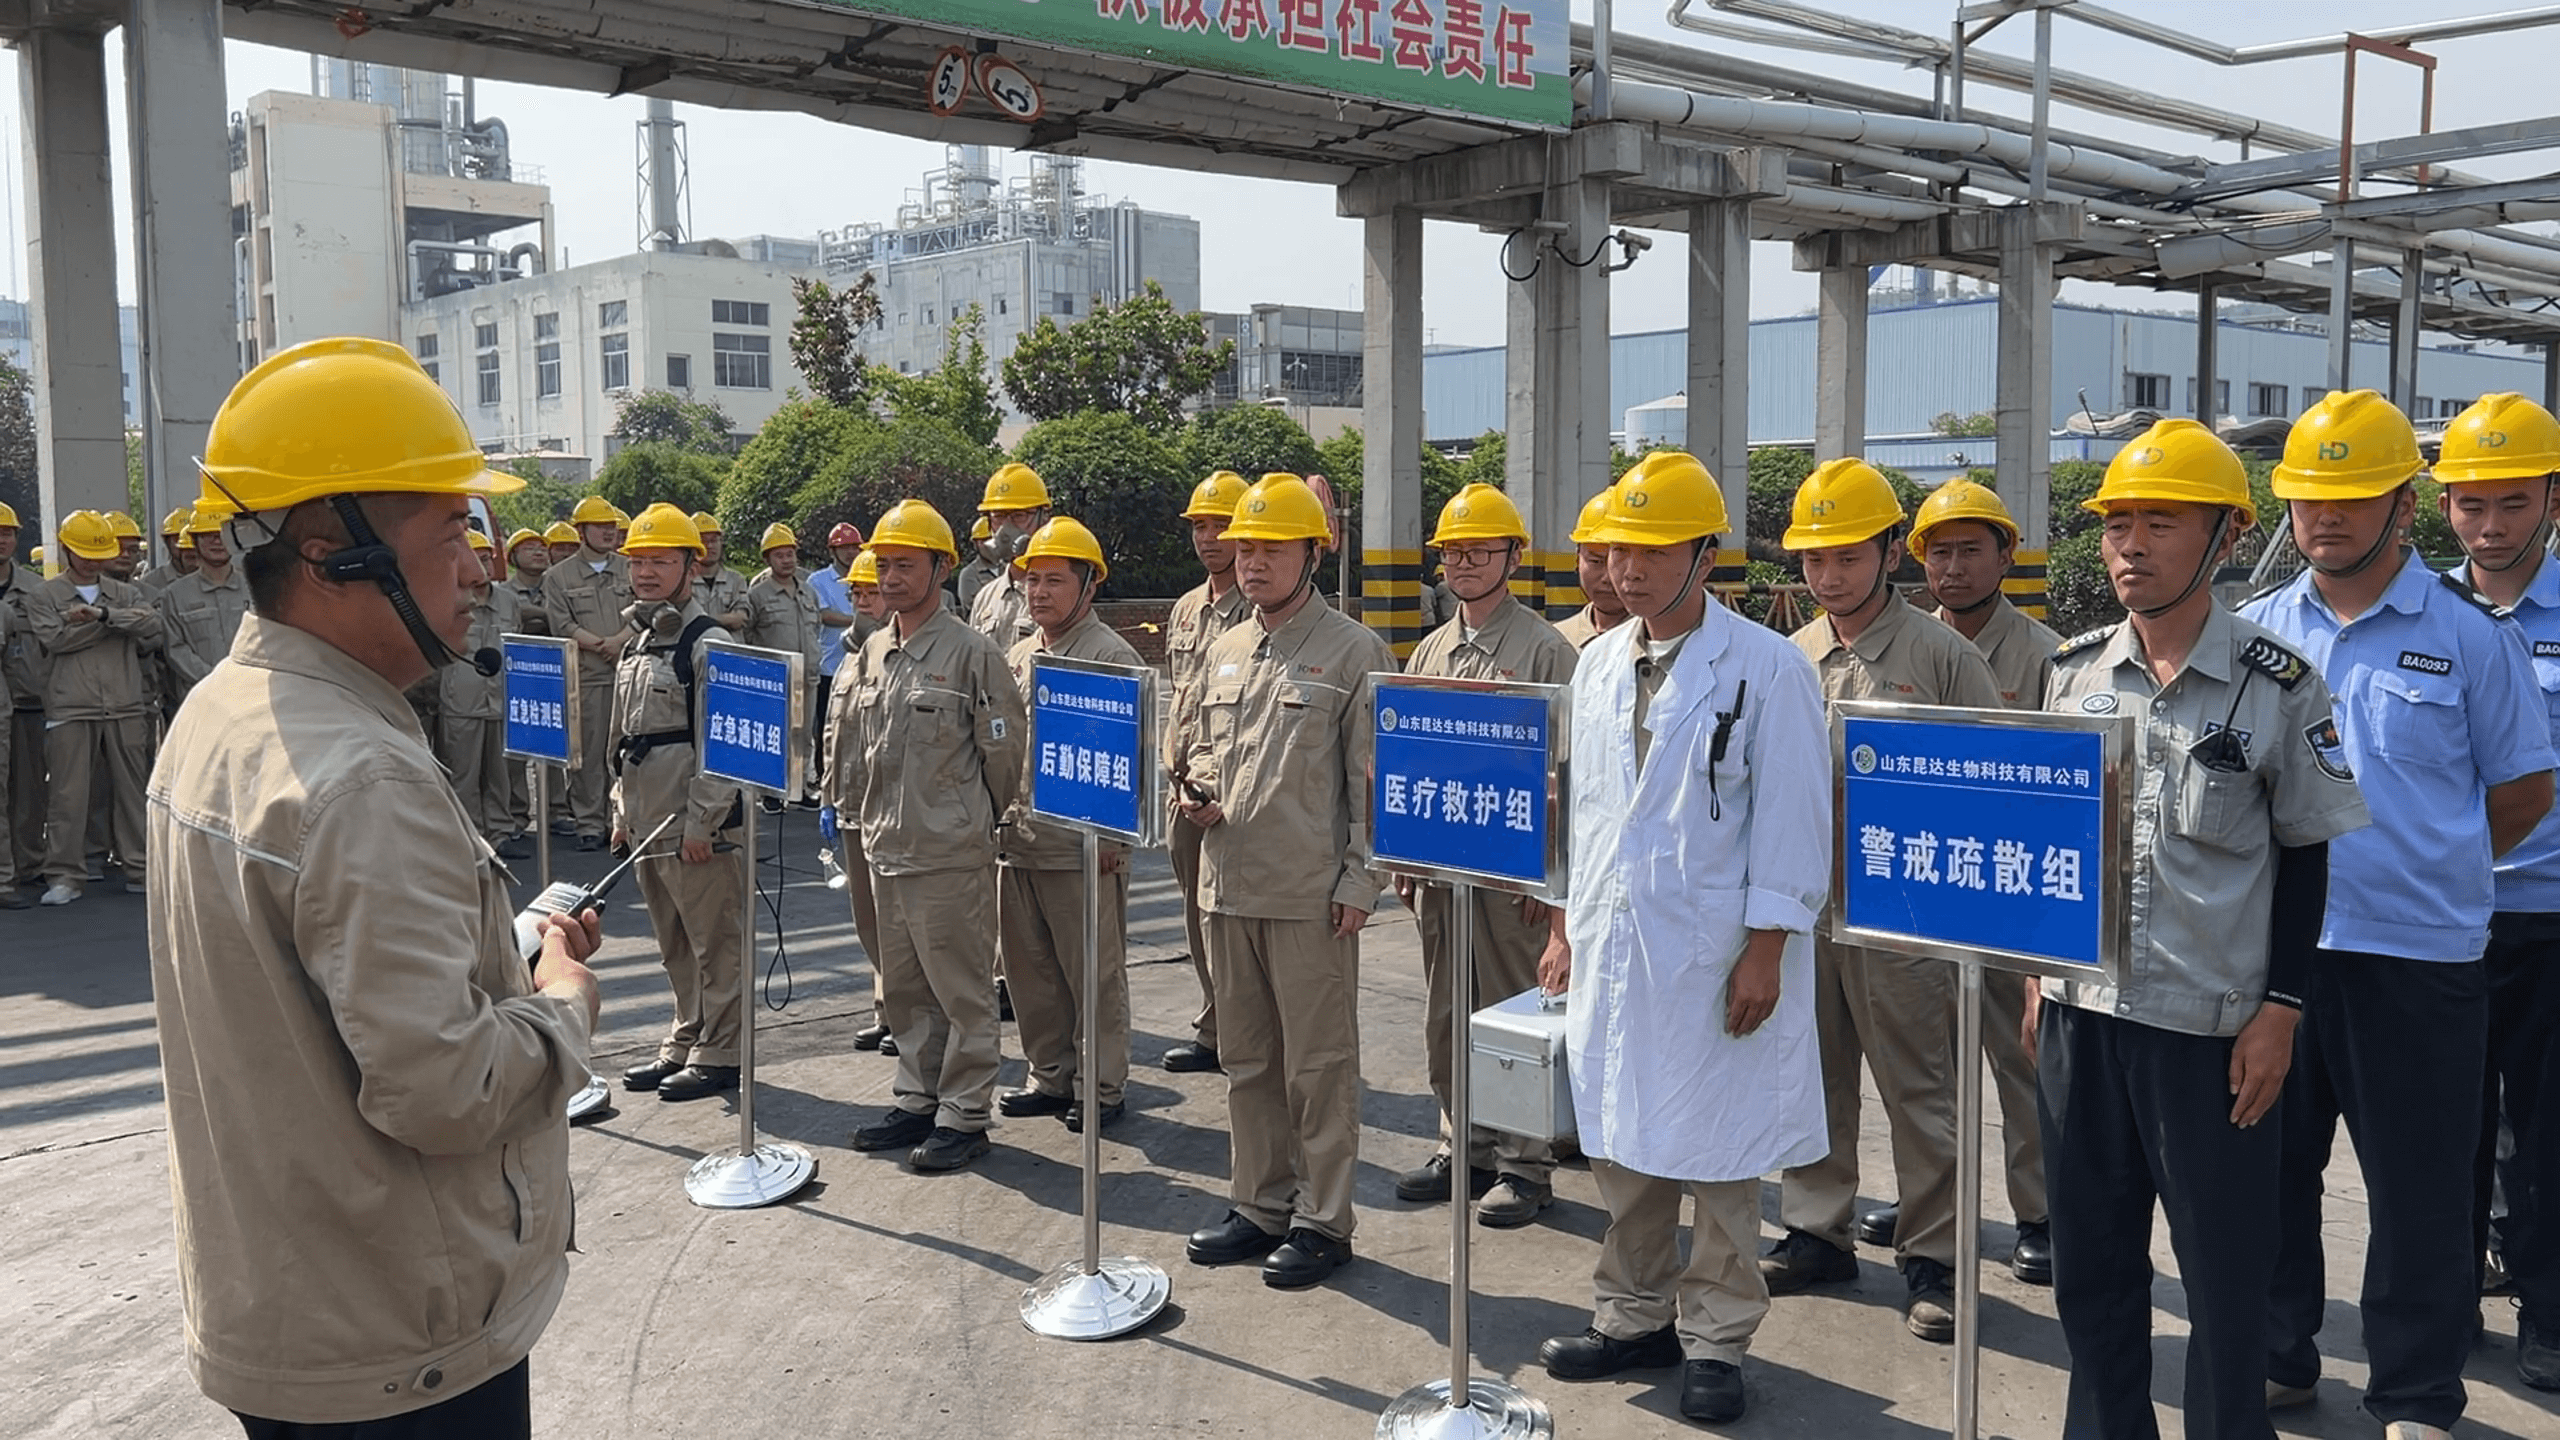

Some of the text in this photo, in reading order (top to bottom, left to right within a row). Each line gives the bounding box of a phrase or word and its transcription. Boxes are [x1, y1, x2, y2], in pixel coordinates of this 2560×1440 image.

[1099, 0, 1535, 88] 担社会责任
[2402, 654, 2449, 673] BA0093
[709, 711, 782, 755] 应急通讯组
[1399, 715, 1539, 743] 山东昆达生物科技有限公司
[1040, 742, 1131, 792] 后勤保障组
[1880, 754, 2091, 788] 山东昆达生物科技有限公司
[1384, 773, 1533, 832] 医疗救护组
[1860, 824, 2084, 902] 警戒疏散组
